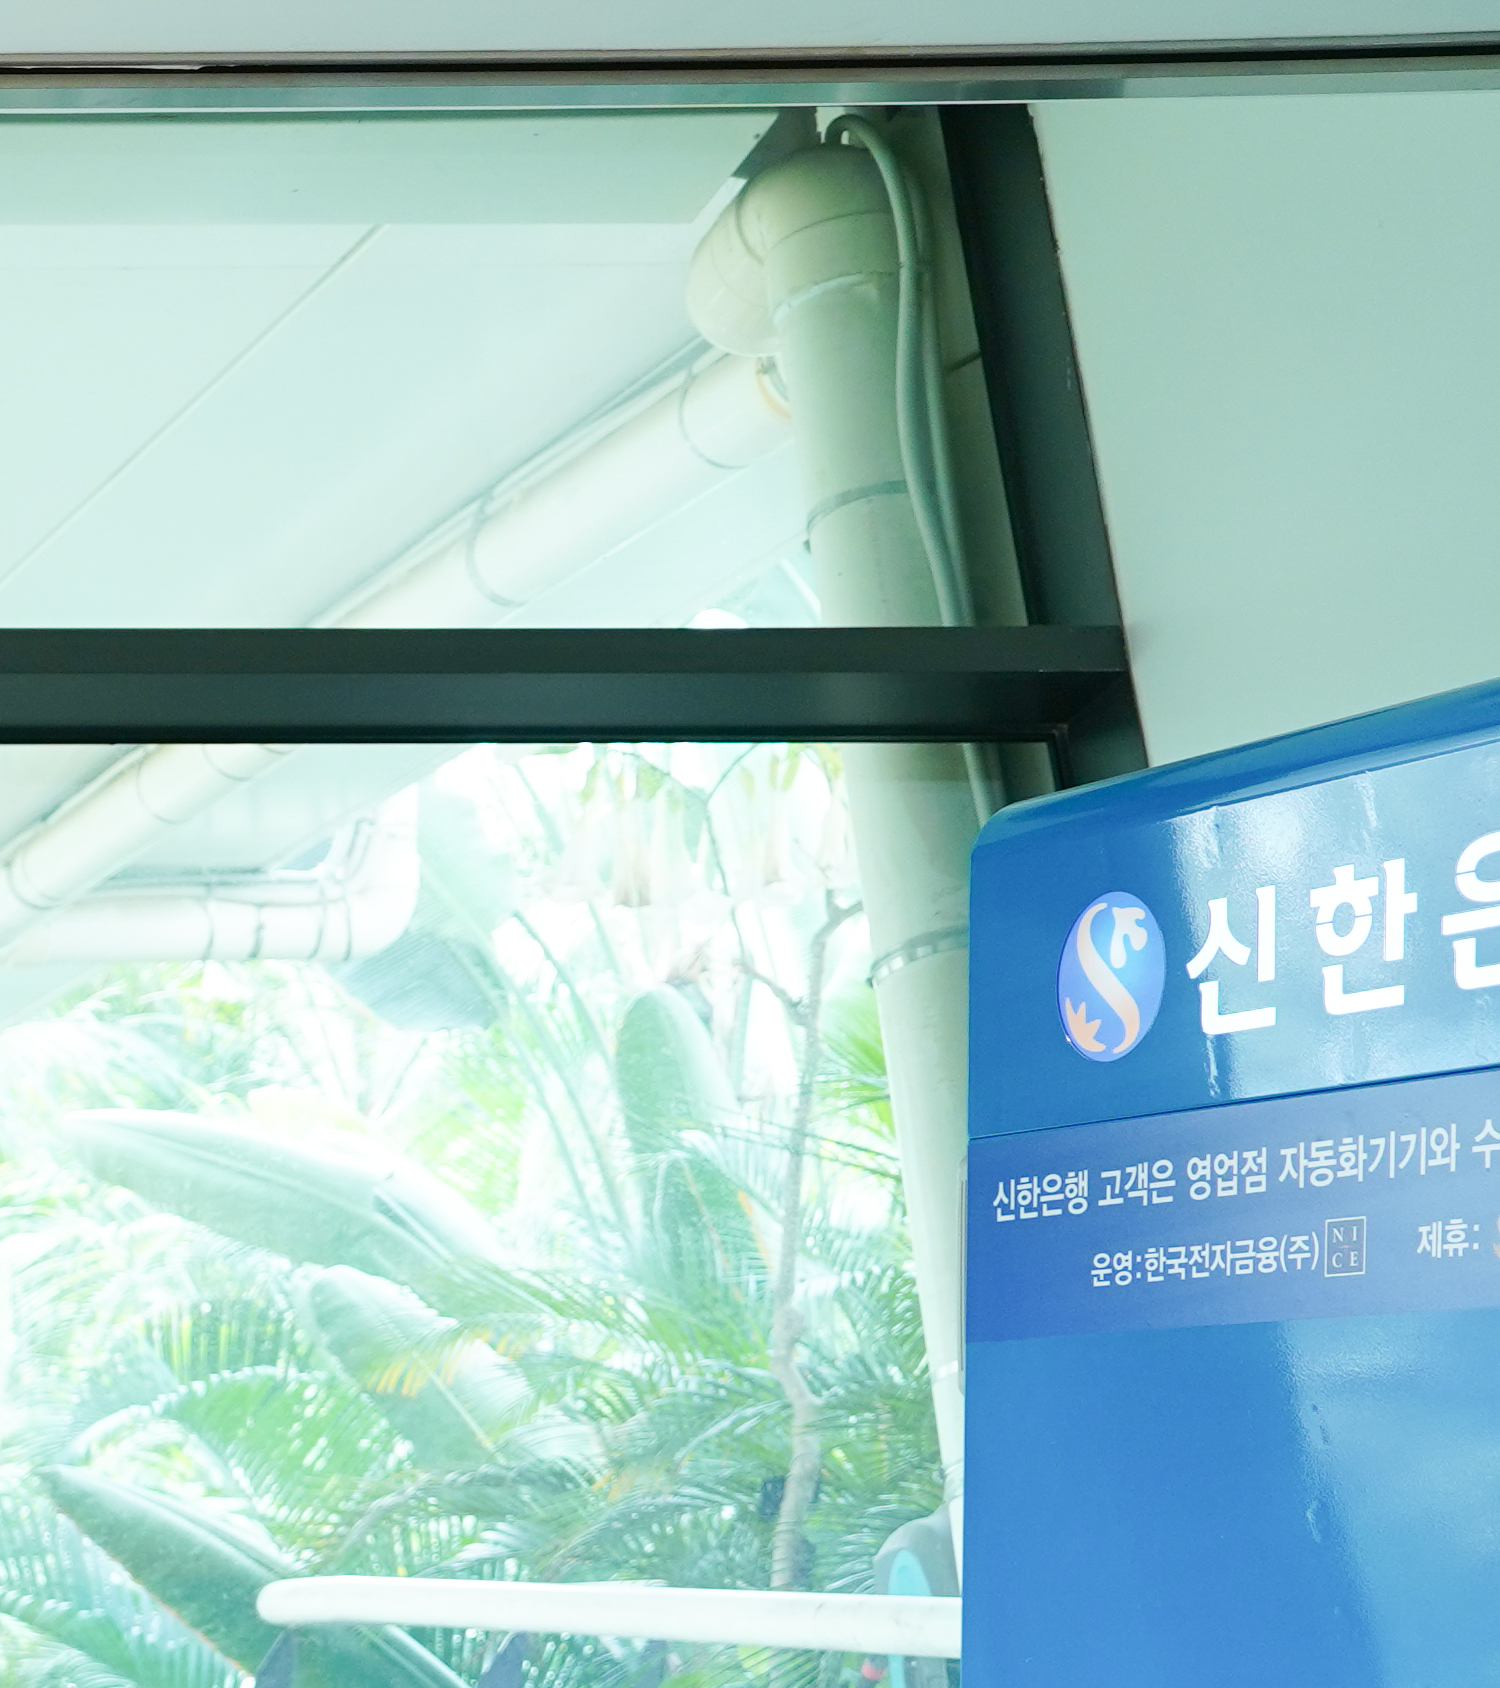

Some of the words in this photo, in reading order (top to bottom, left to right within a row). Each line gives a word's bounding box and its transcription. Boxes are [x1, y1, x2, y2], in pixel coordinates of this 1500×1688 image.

[993, 1168, 1089, 1223] 신한은행
[1098, 1159, 1176, 1207] 고객은
[1187, 1146, 1267, 1200] 영업점
[1279, 1123, 1460, 1189] 자동화기기와
[1417, 1218, 1479, 1260] 제휴:
